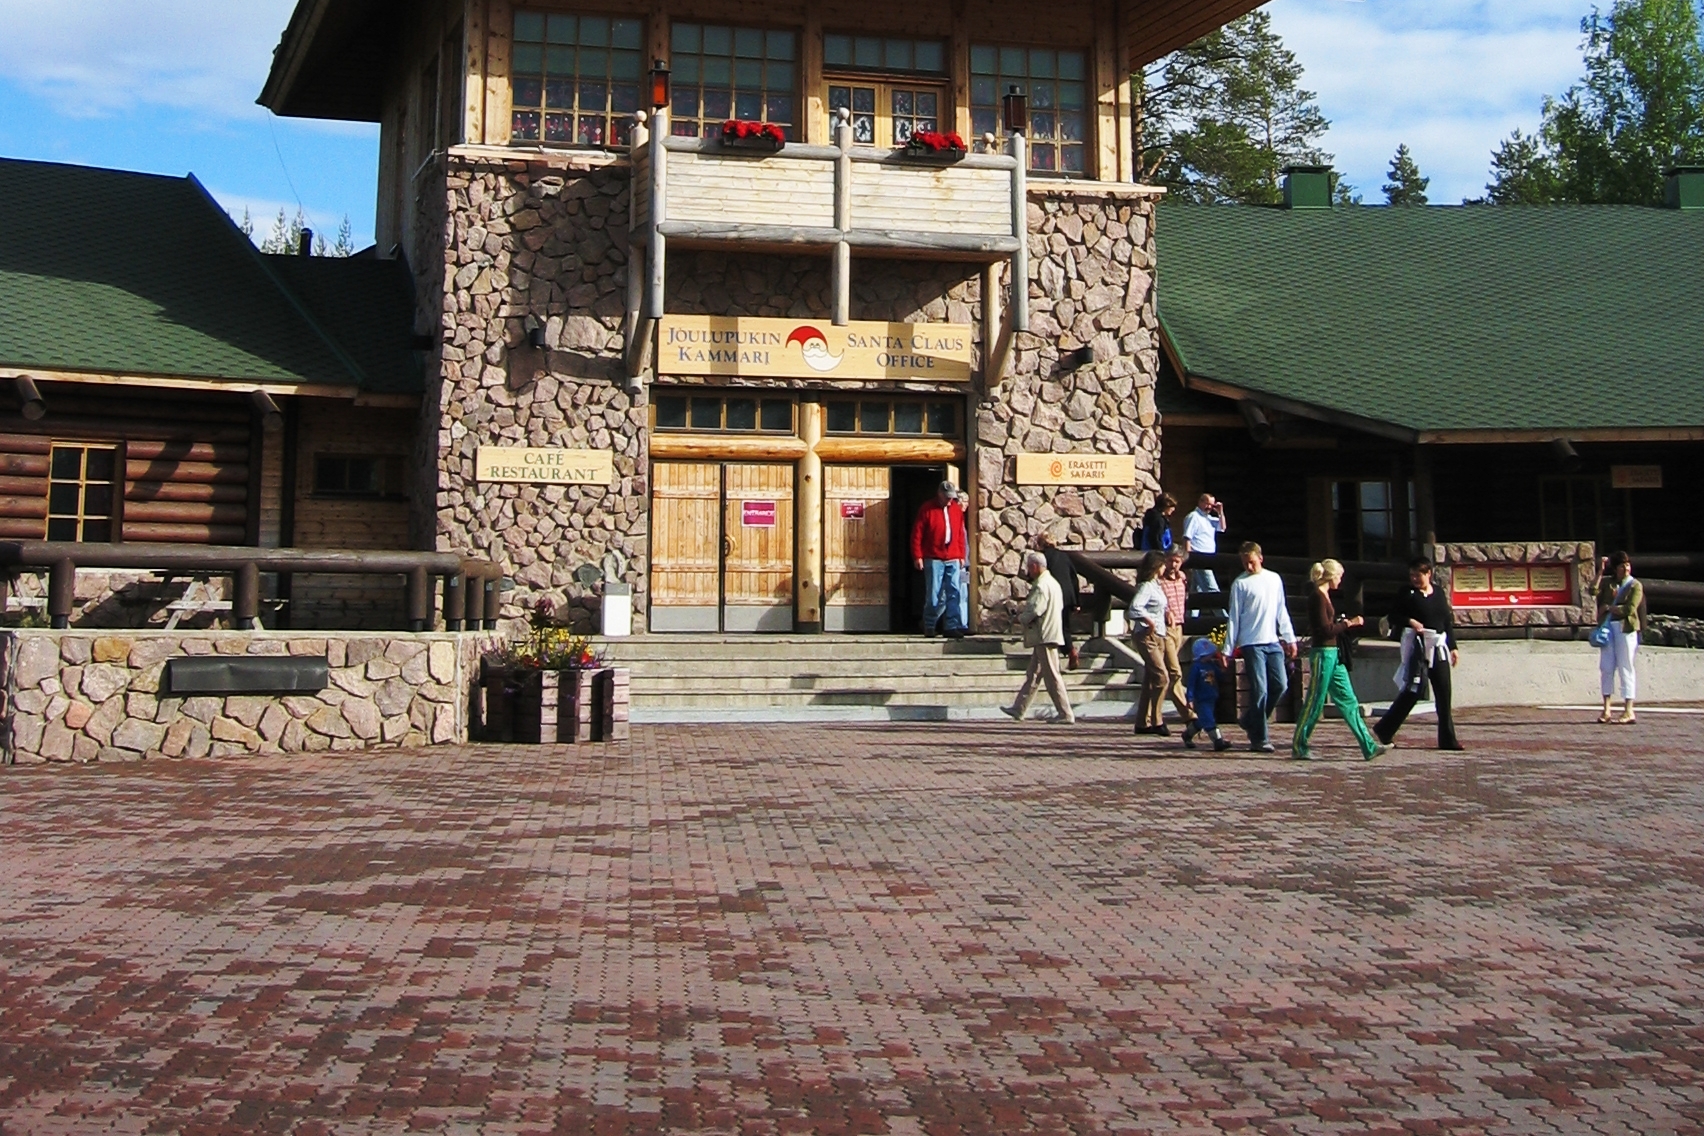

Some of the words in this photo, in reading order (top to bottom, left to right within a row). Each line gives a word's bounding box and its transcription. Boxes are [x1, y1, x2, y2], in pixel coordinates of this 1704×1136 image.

[667, 326, 781, 346] JOULUPUKIN
[847, 332, 904, 349] SANTA
[911, 334, 963, 351] CLAUS
[678, 346, 770, 365] KAMMARI
[876, 352, 934, 369] OFFICE
[524, 450, 565, 465] CAFÉ
[1068, 460, 1107, 469] ERASETTI
[490, 466, 597, 480] RESTAURANT
[1070, 470, 1105, 479] SAFARIS
